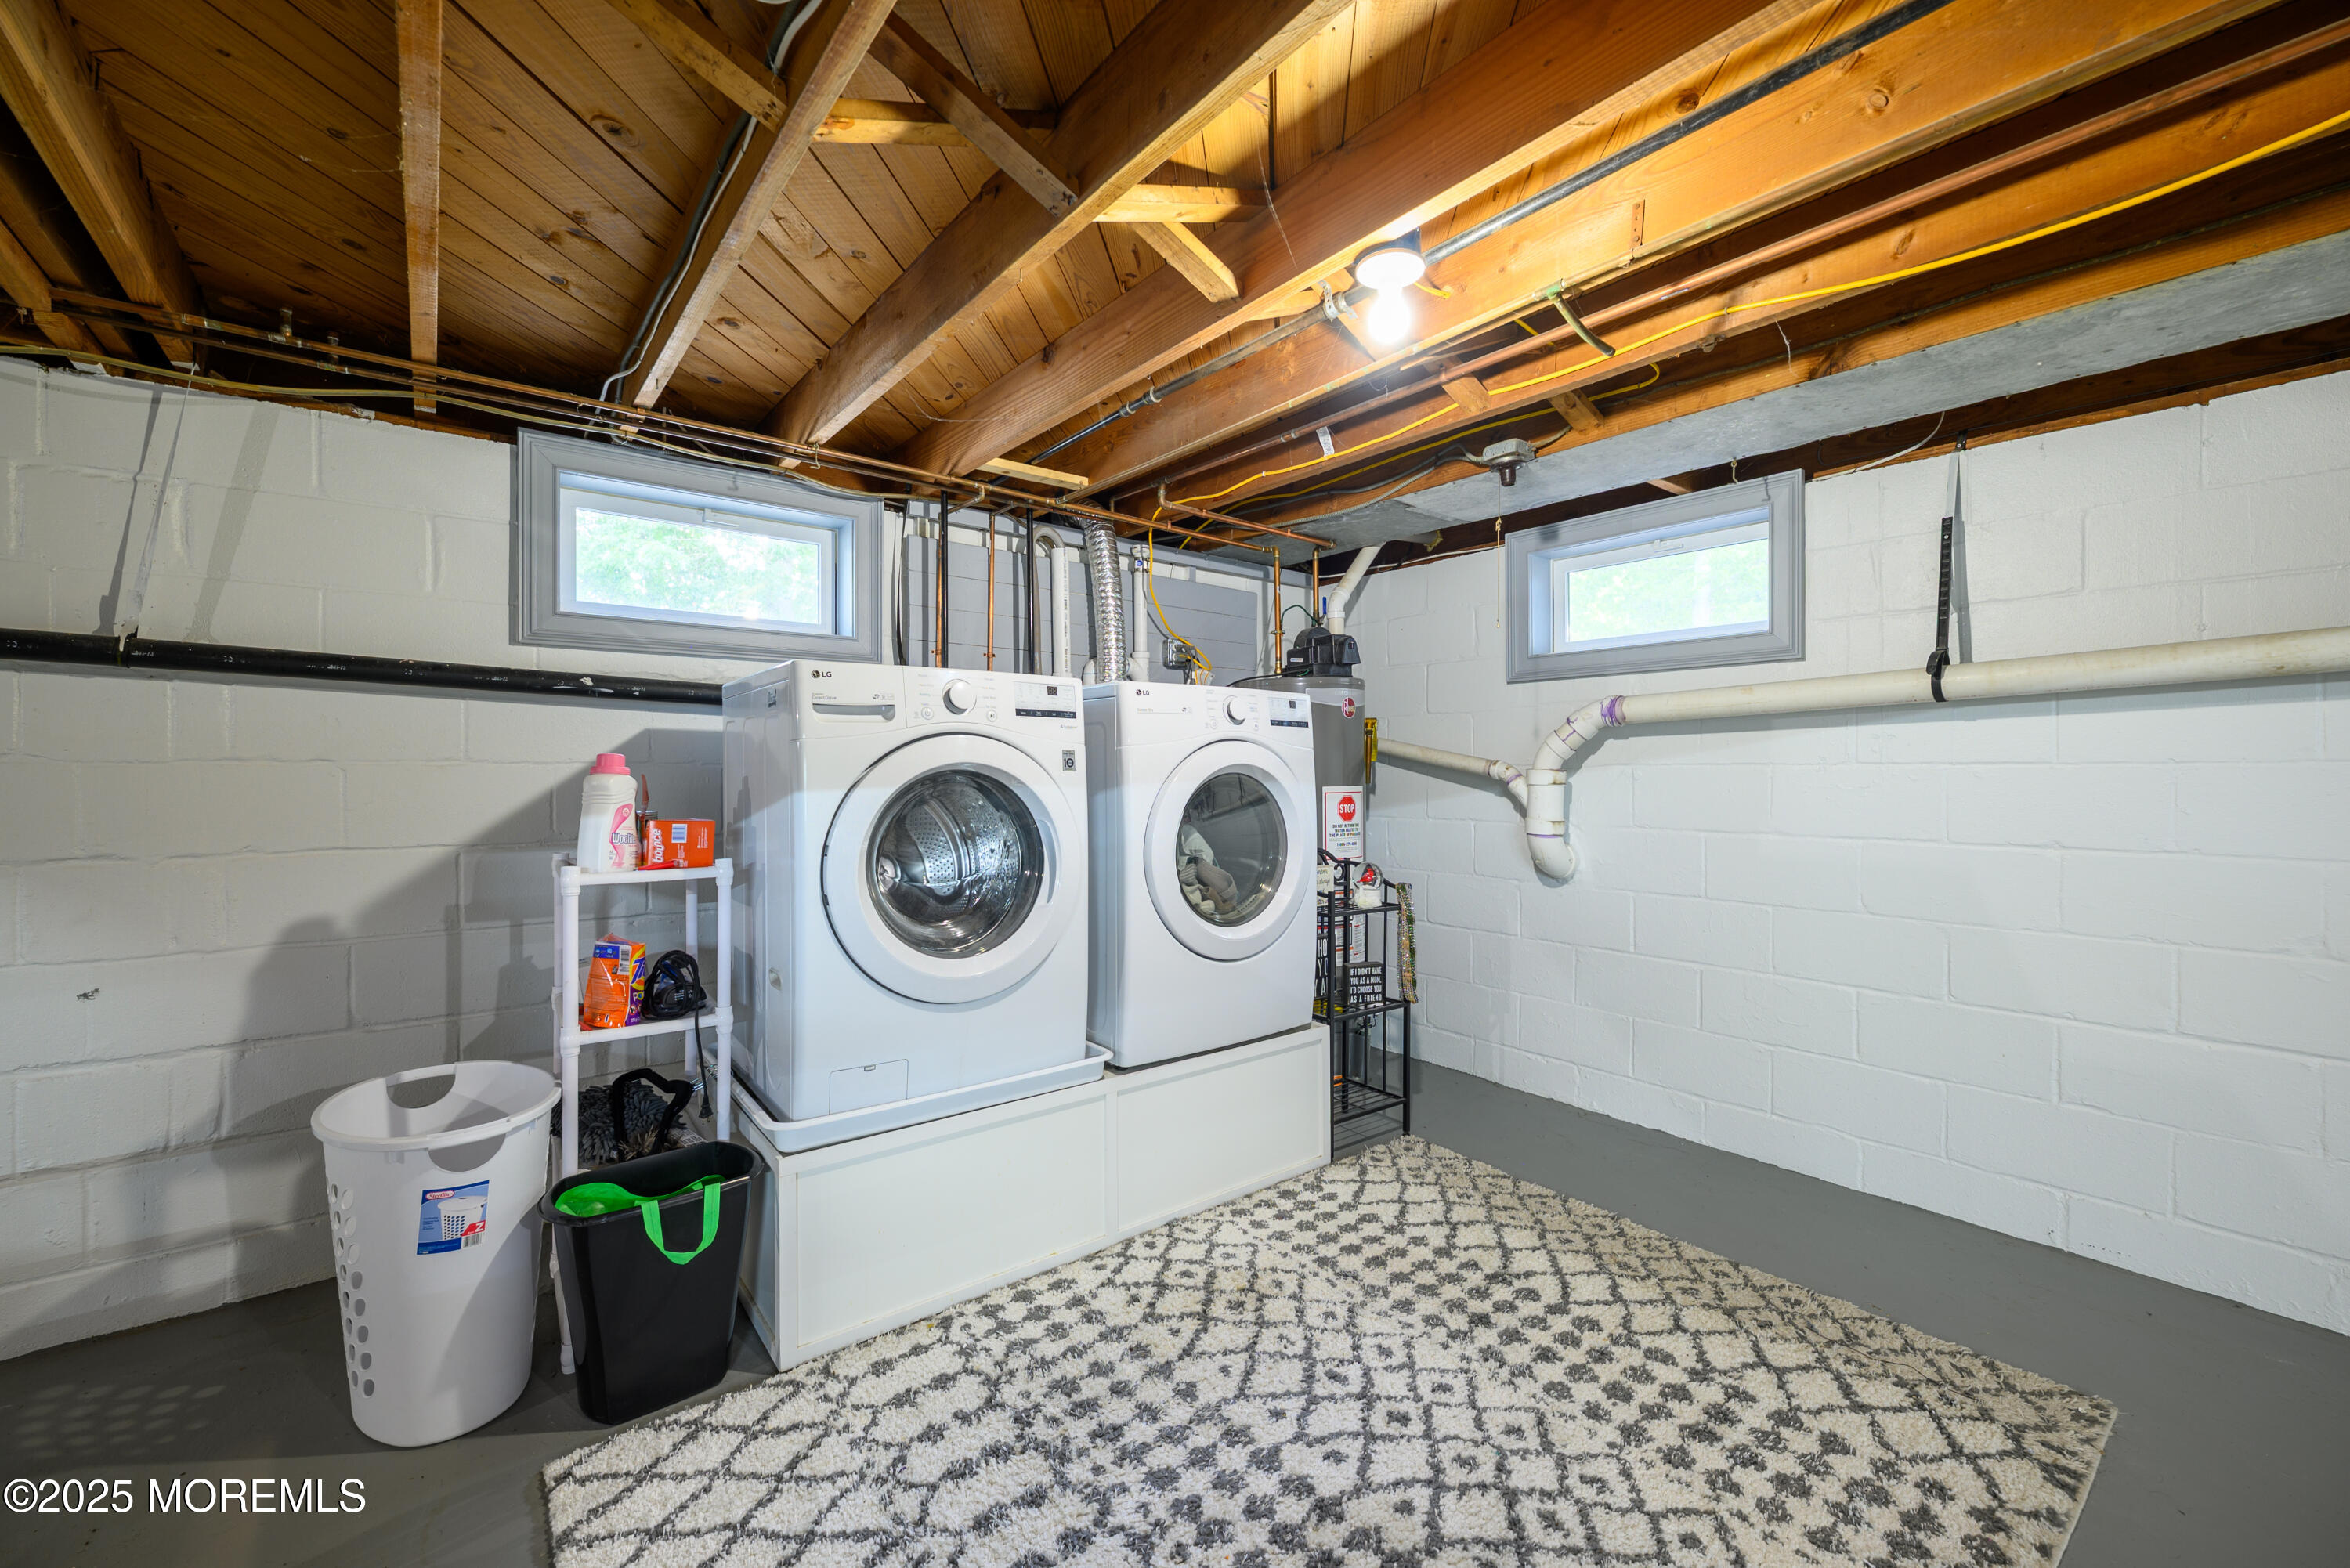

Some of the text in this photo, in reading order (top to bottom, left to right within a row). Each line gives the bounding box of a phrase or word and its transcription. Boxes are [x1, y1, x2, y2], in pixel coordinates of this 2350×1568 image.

[1340, 804, 1354, 813] STOP
[652, 828, 664, 862] bounce
[631, 956, 645, 985] Ti
